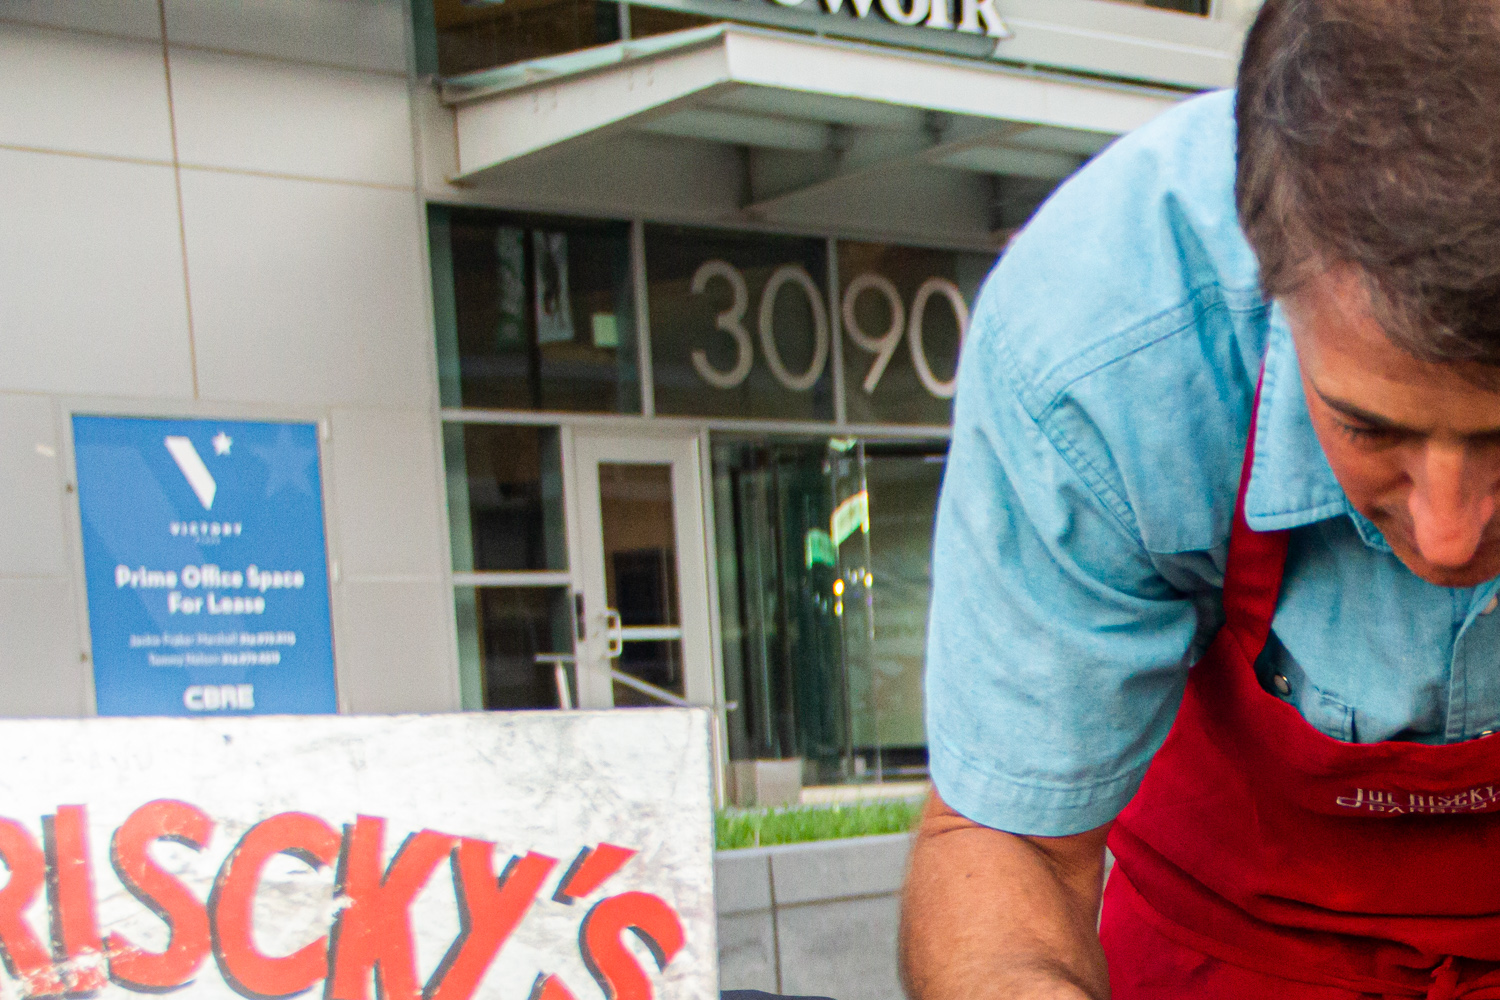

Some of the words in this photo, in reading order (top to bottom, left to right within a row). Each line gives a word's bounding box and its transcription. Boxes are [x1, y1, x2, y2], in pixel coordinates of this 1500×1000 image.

[692, 260, 970, 398] 3090
[115, 564, 178, 589] Prime
[181, 564, 244, 589] Office
[246, 563, 305, 593] Space
[167, 591, 204, 615] For
[207, 591, 266, 615] Lease
[183, 684, 255, 711] CBRE
